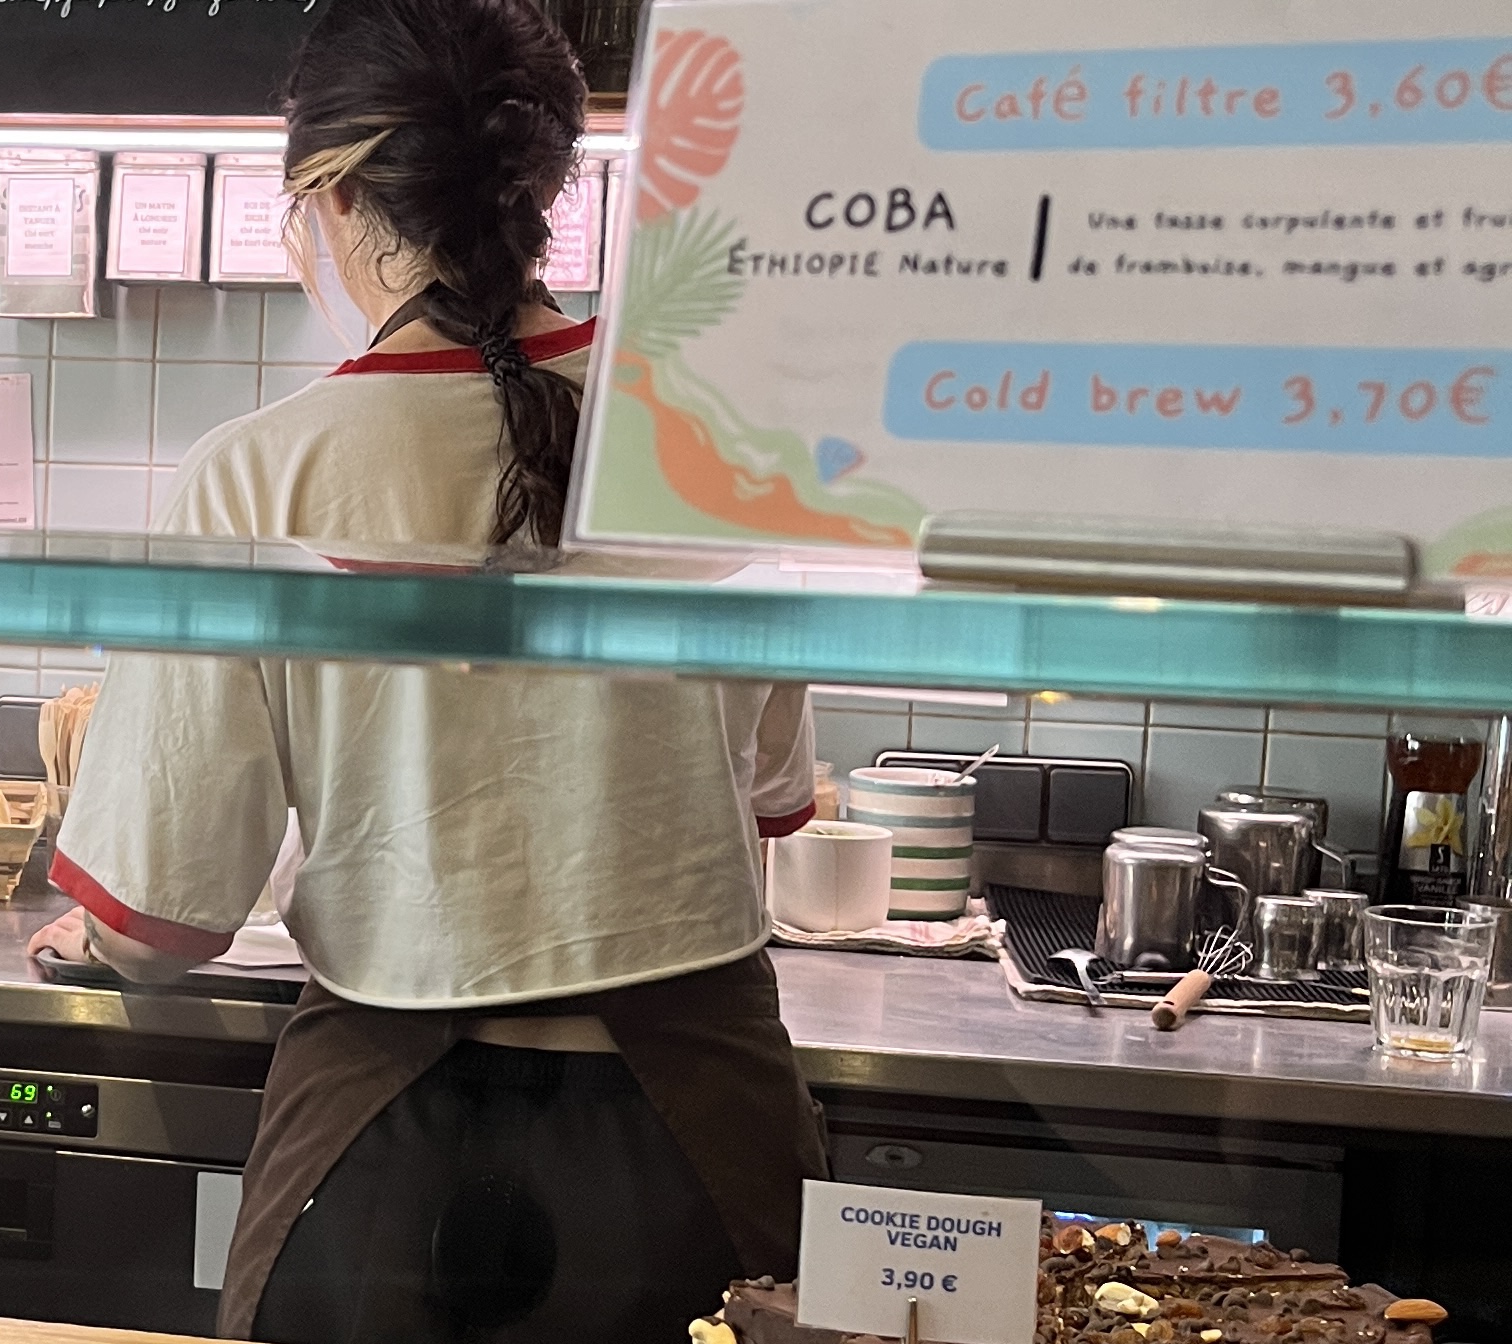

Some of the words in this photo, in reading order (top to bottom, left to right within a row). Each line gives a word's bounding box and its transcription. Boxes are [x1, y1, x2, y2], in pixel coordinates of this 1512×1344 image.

[955, 65, 1088, 122] Café
[1124, 74, 1280, 118] filtre
[806, 187, 955, 233] COBA
[899, 254, 1009, 277] Nature
[924, 369, 1051, 412] Cold
[1090, 373, 1242, 418] brew
[9, 1083, 37, 1102] 69
[841, 1206, 921, 1231] COOKIE
[926, 1215, 1002, 1238] DOUGH
[886, 1229, 958, 1252] VEGAN
[880, 1268, 934, 1291] 3,90
[942, 1274, 958, 1292] €
